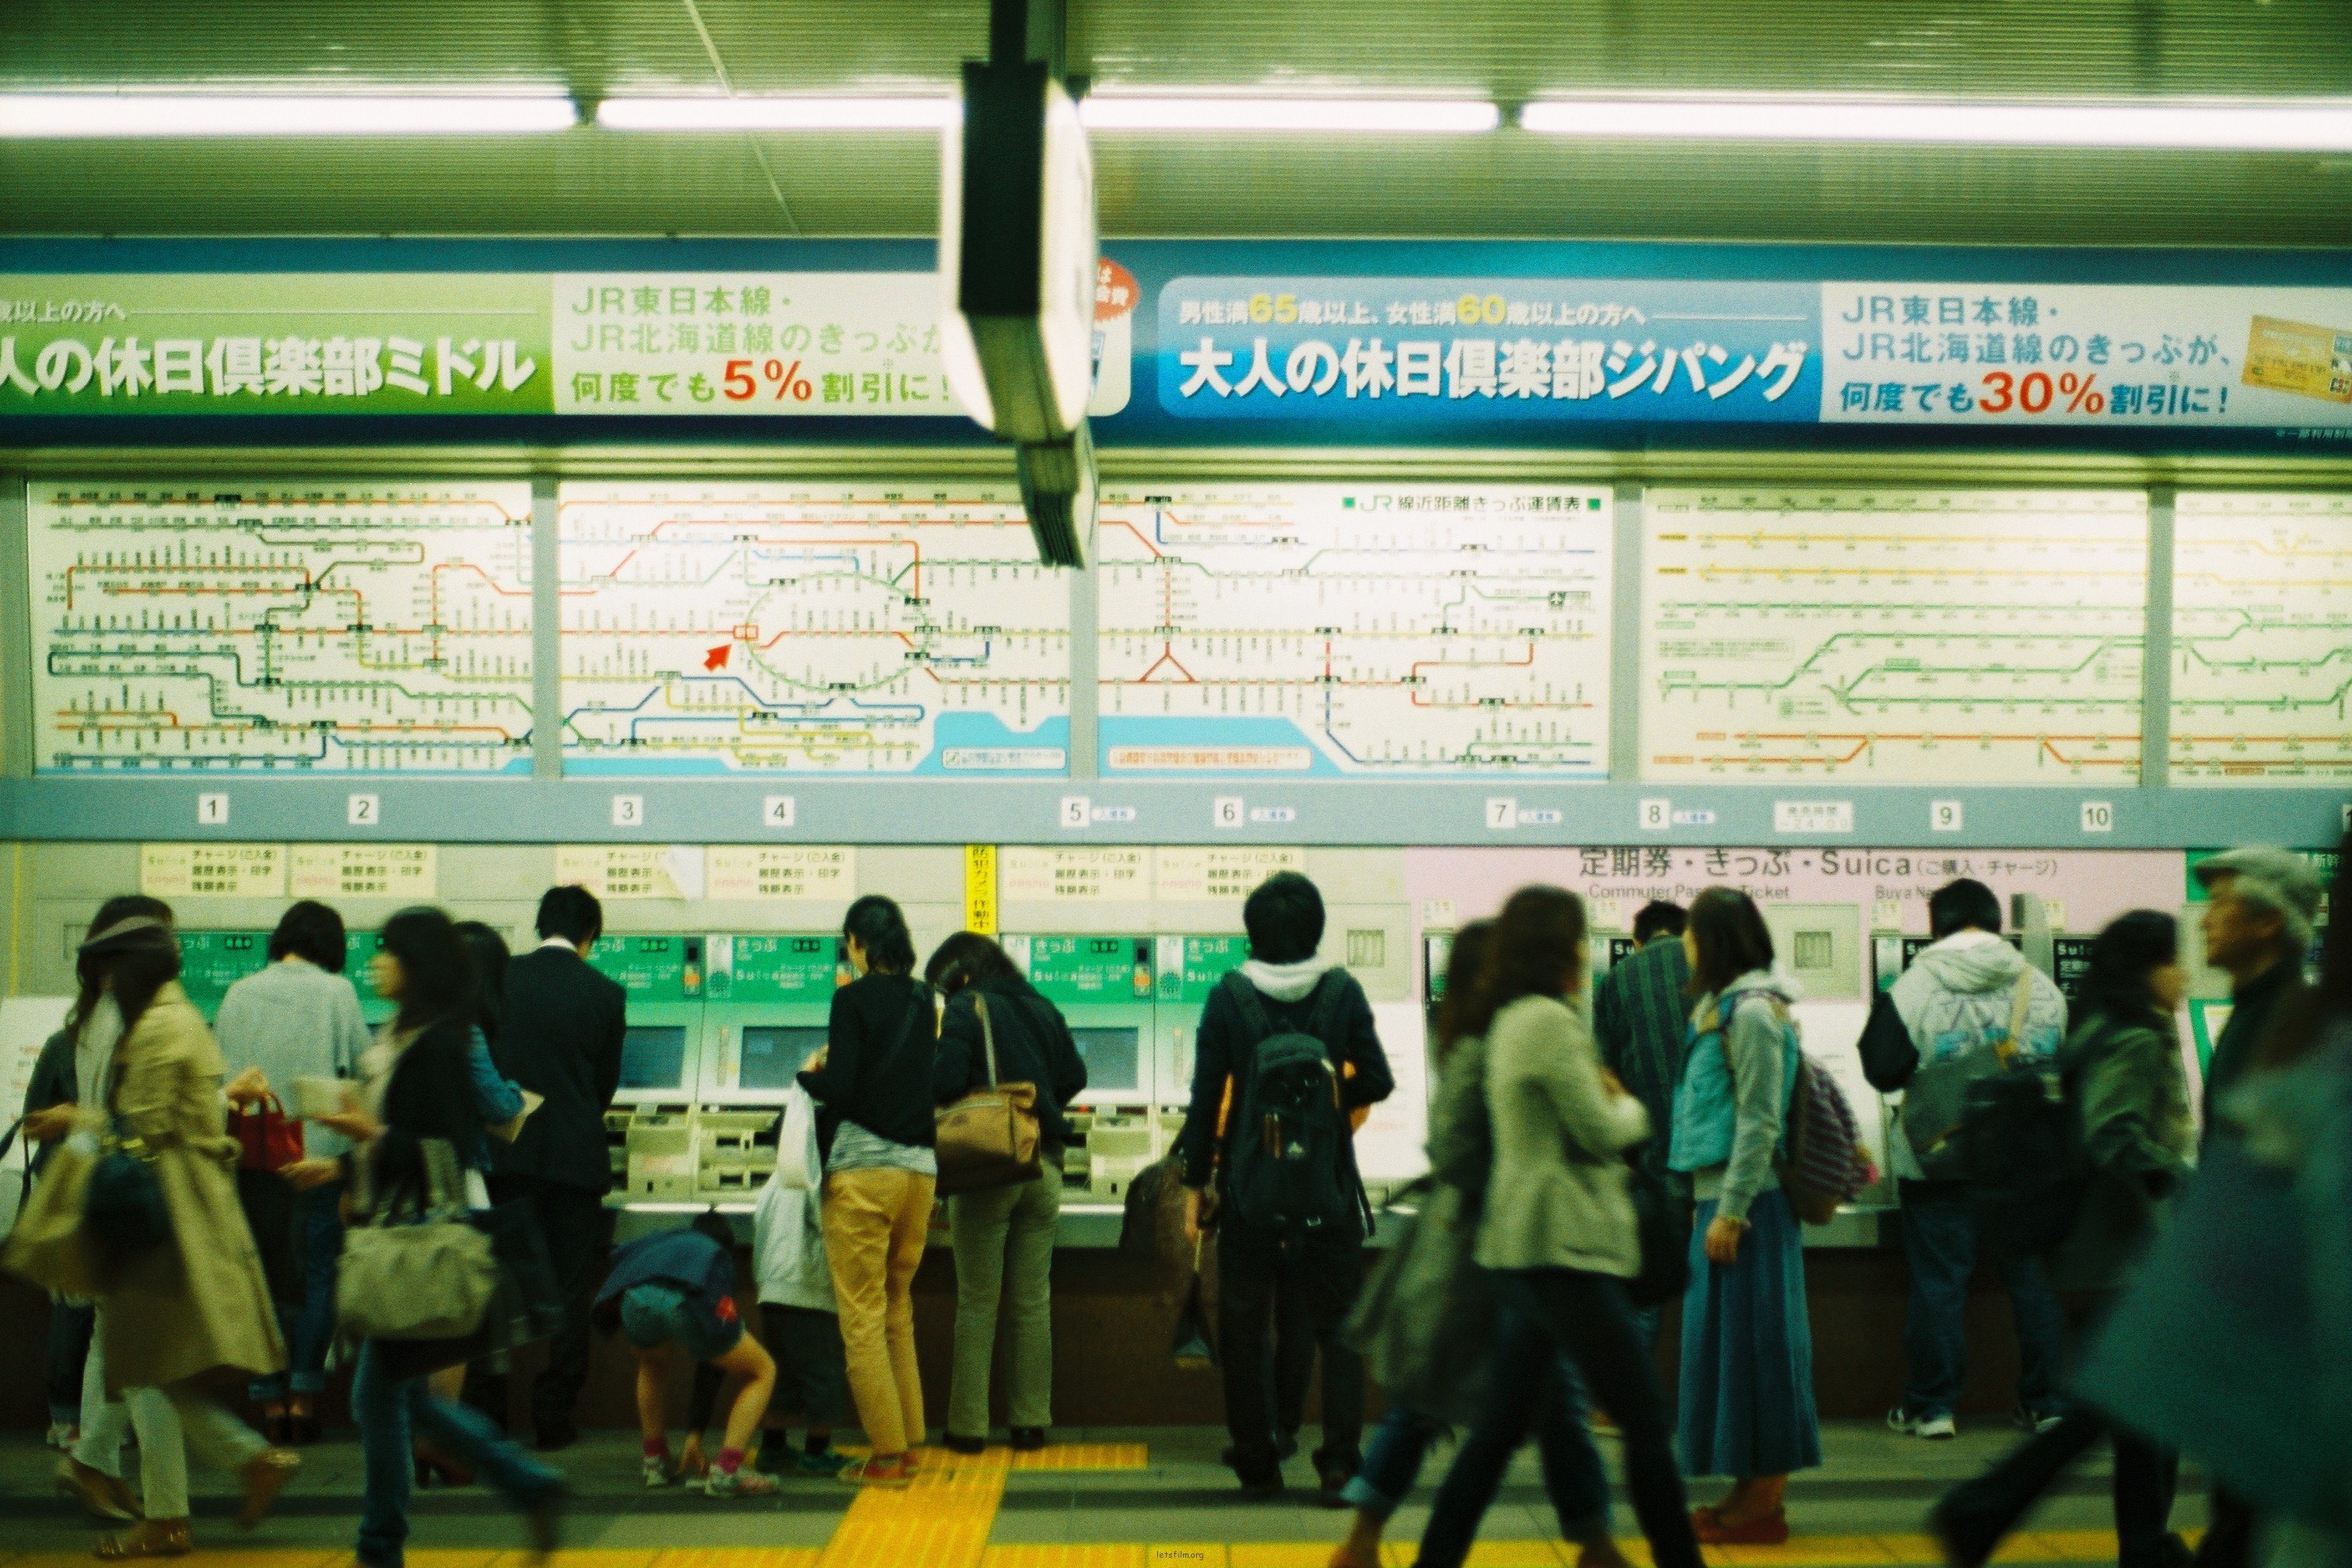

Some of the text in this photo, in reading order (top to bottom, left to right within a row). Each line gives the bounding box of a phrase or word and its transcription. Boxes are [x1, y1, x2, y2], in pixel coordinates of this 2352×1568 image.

[1178, 338, 1808, 402] 大人の休日倶楽部ジパング
[208, 801, 218, 818] 1
[358, 801, 369, 818] 2
[622, 803, 634, 821] 3
[773, 803, 786, 820] 4
[1070, 803, 1081, 821] 5
[1223, 803, 1234, 821] 6
[1496, 804, 1507, 822] 7
[1649, 805, 1661, 823] 8
[1940, 807, 1951, 824] 9
[2085, 808, 2108, 826] 10
[1589, 884, 1671, 899] Commuter
